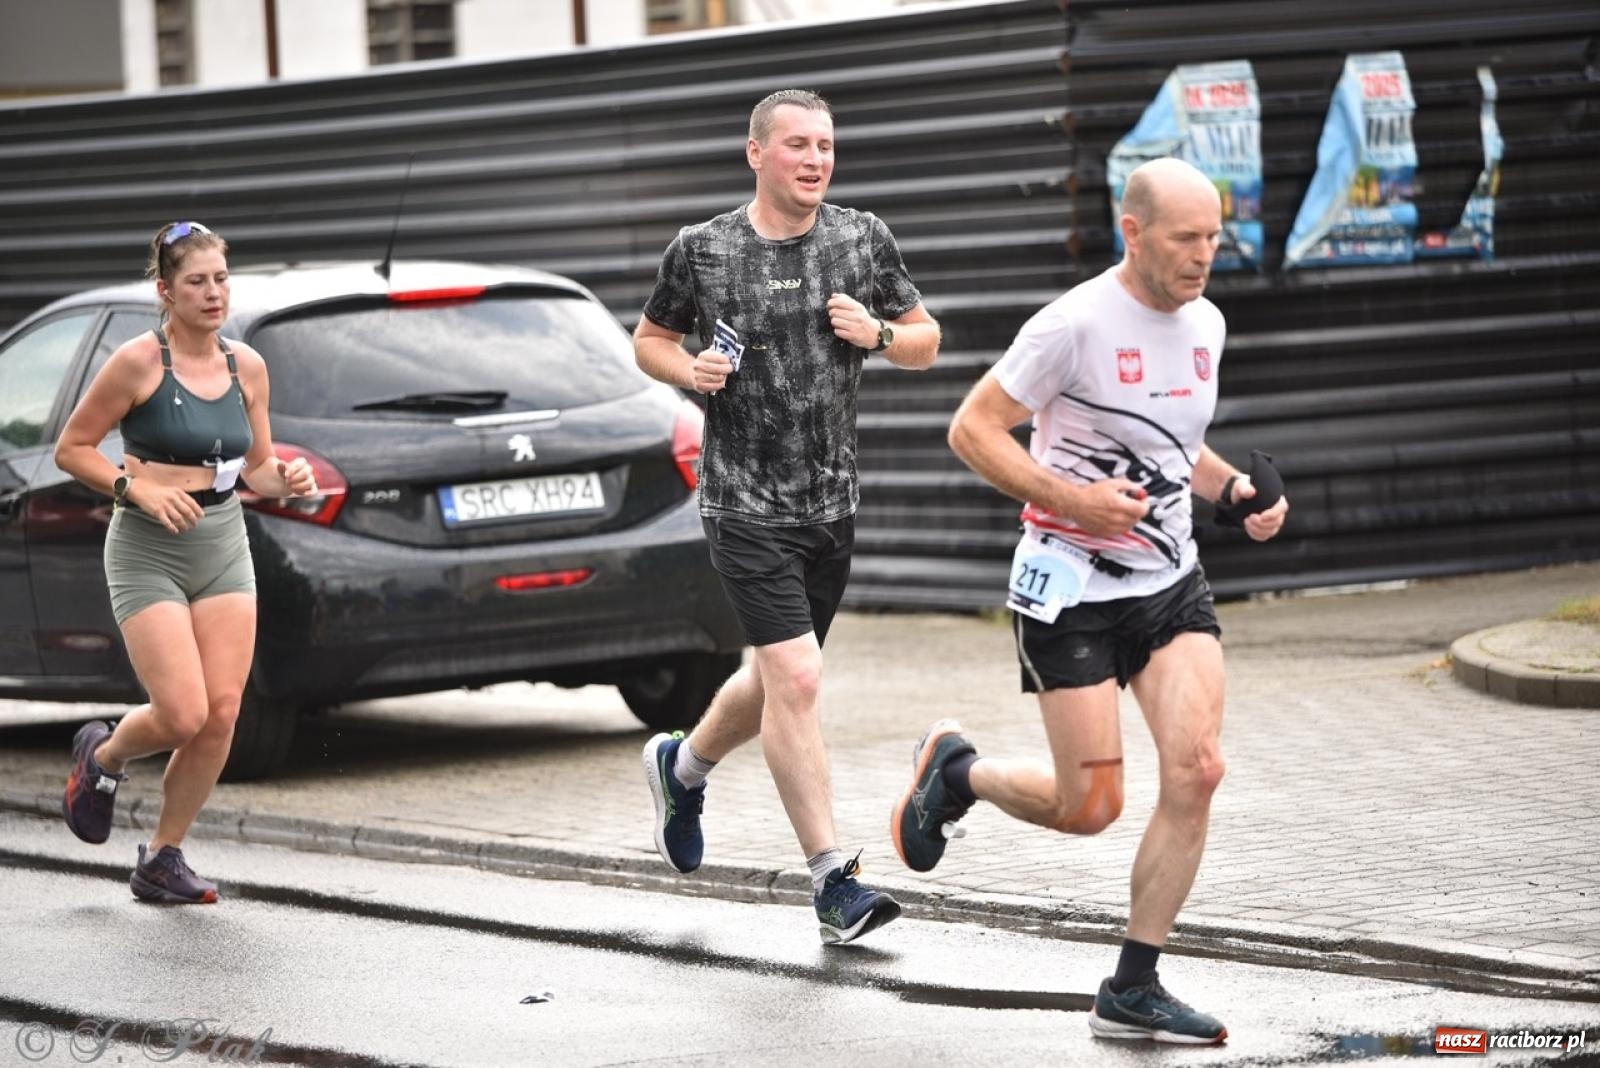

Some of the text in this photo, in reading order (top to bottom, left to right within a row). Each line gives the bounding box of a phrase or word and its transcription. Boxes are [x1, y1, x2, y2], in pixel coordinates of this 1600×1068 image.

[461, 477, 598, 520] SRC XH94
[1015, 562, 1051, 596] 211
